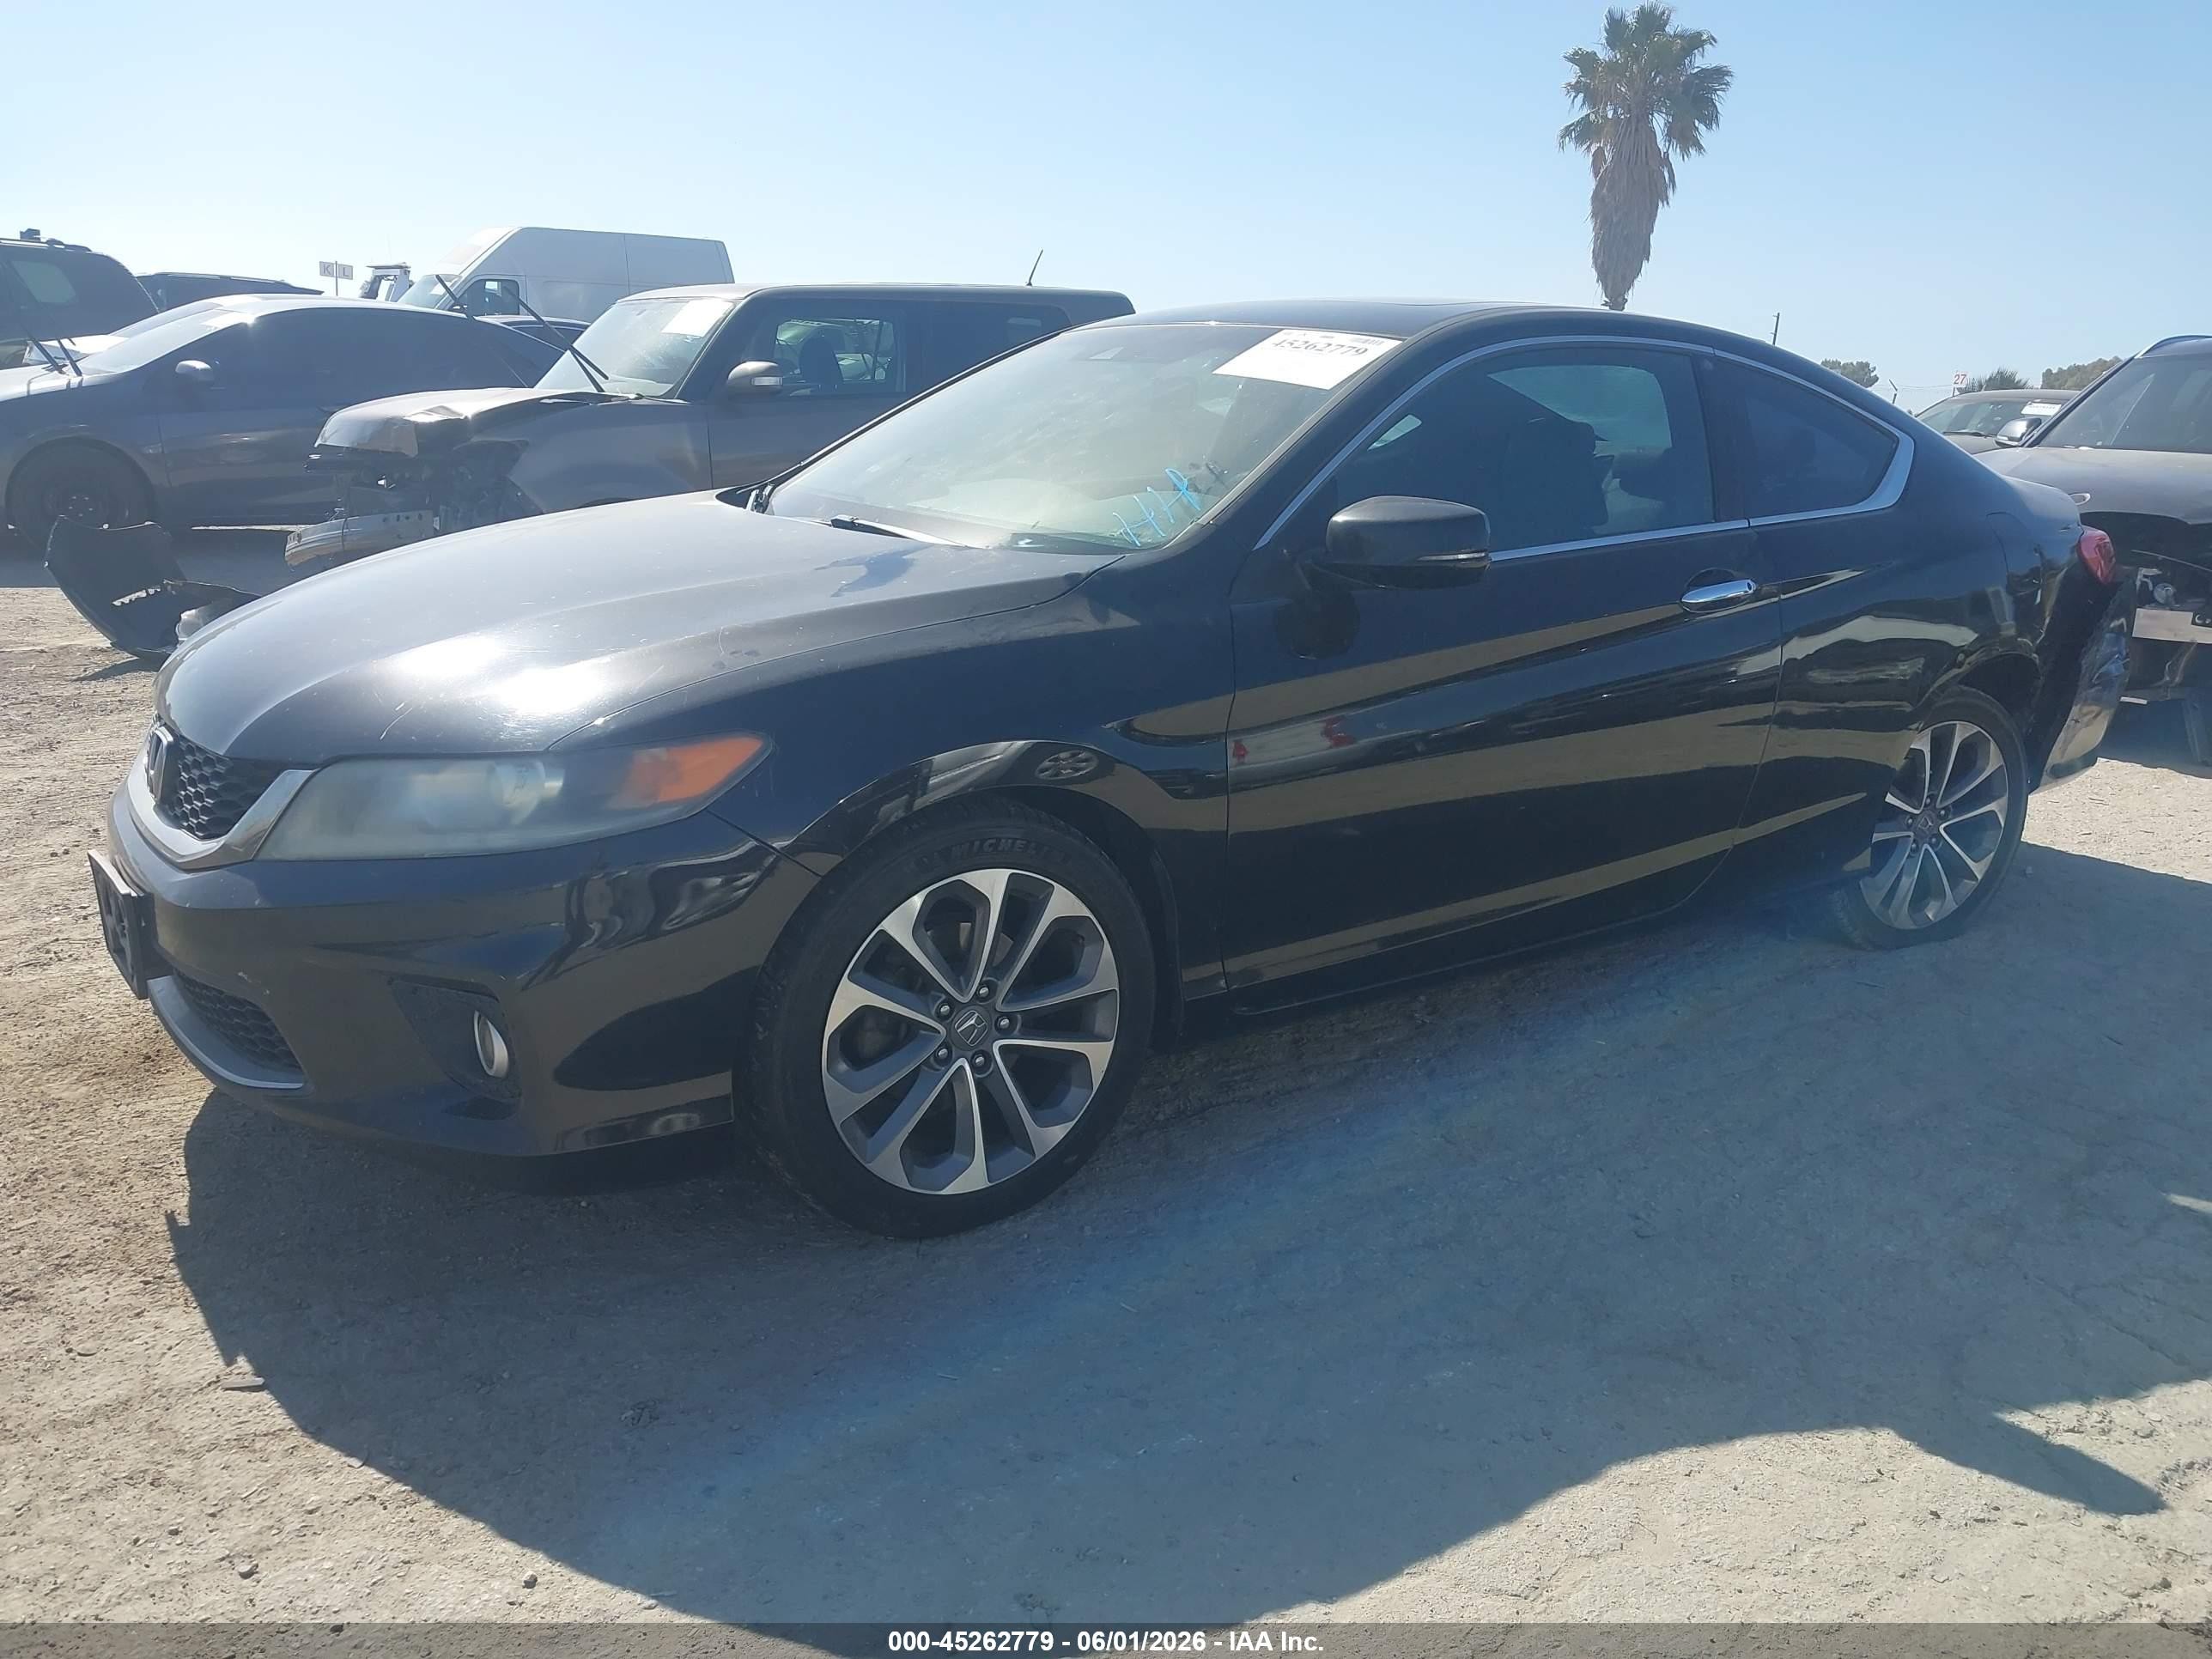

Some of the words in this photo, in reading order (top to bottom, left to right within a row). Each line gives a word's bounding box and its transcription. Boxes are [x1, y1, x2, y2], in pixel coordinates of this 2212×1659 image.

[323, 264, 331, 275] K
[343, 266, 349, 277] L
[1271, 338, 1369, 356] 45262779
[1954, 374, 1967, 385] 27
